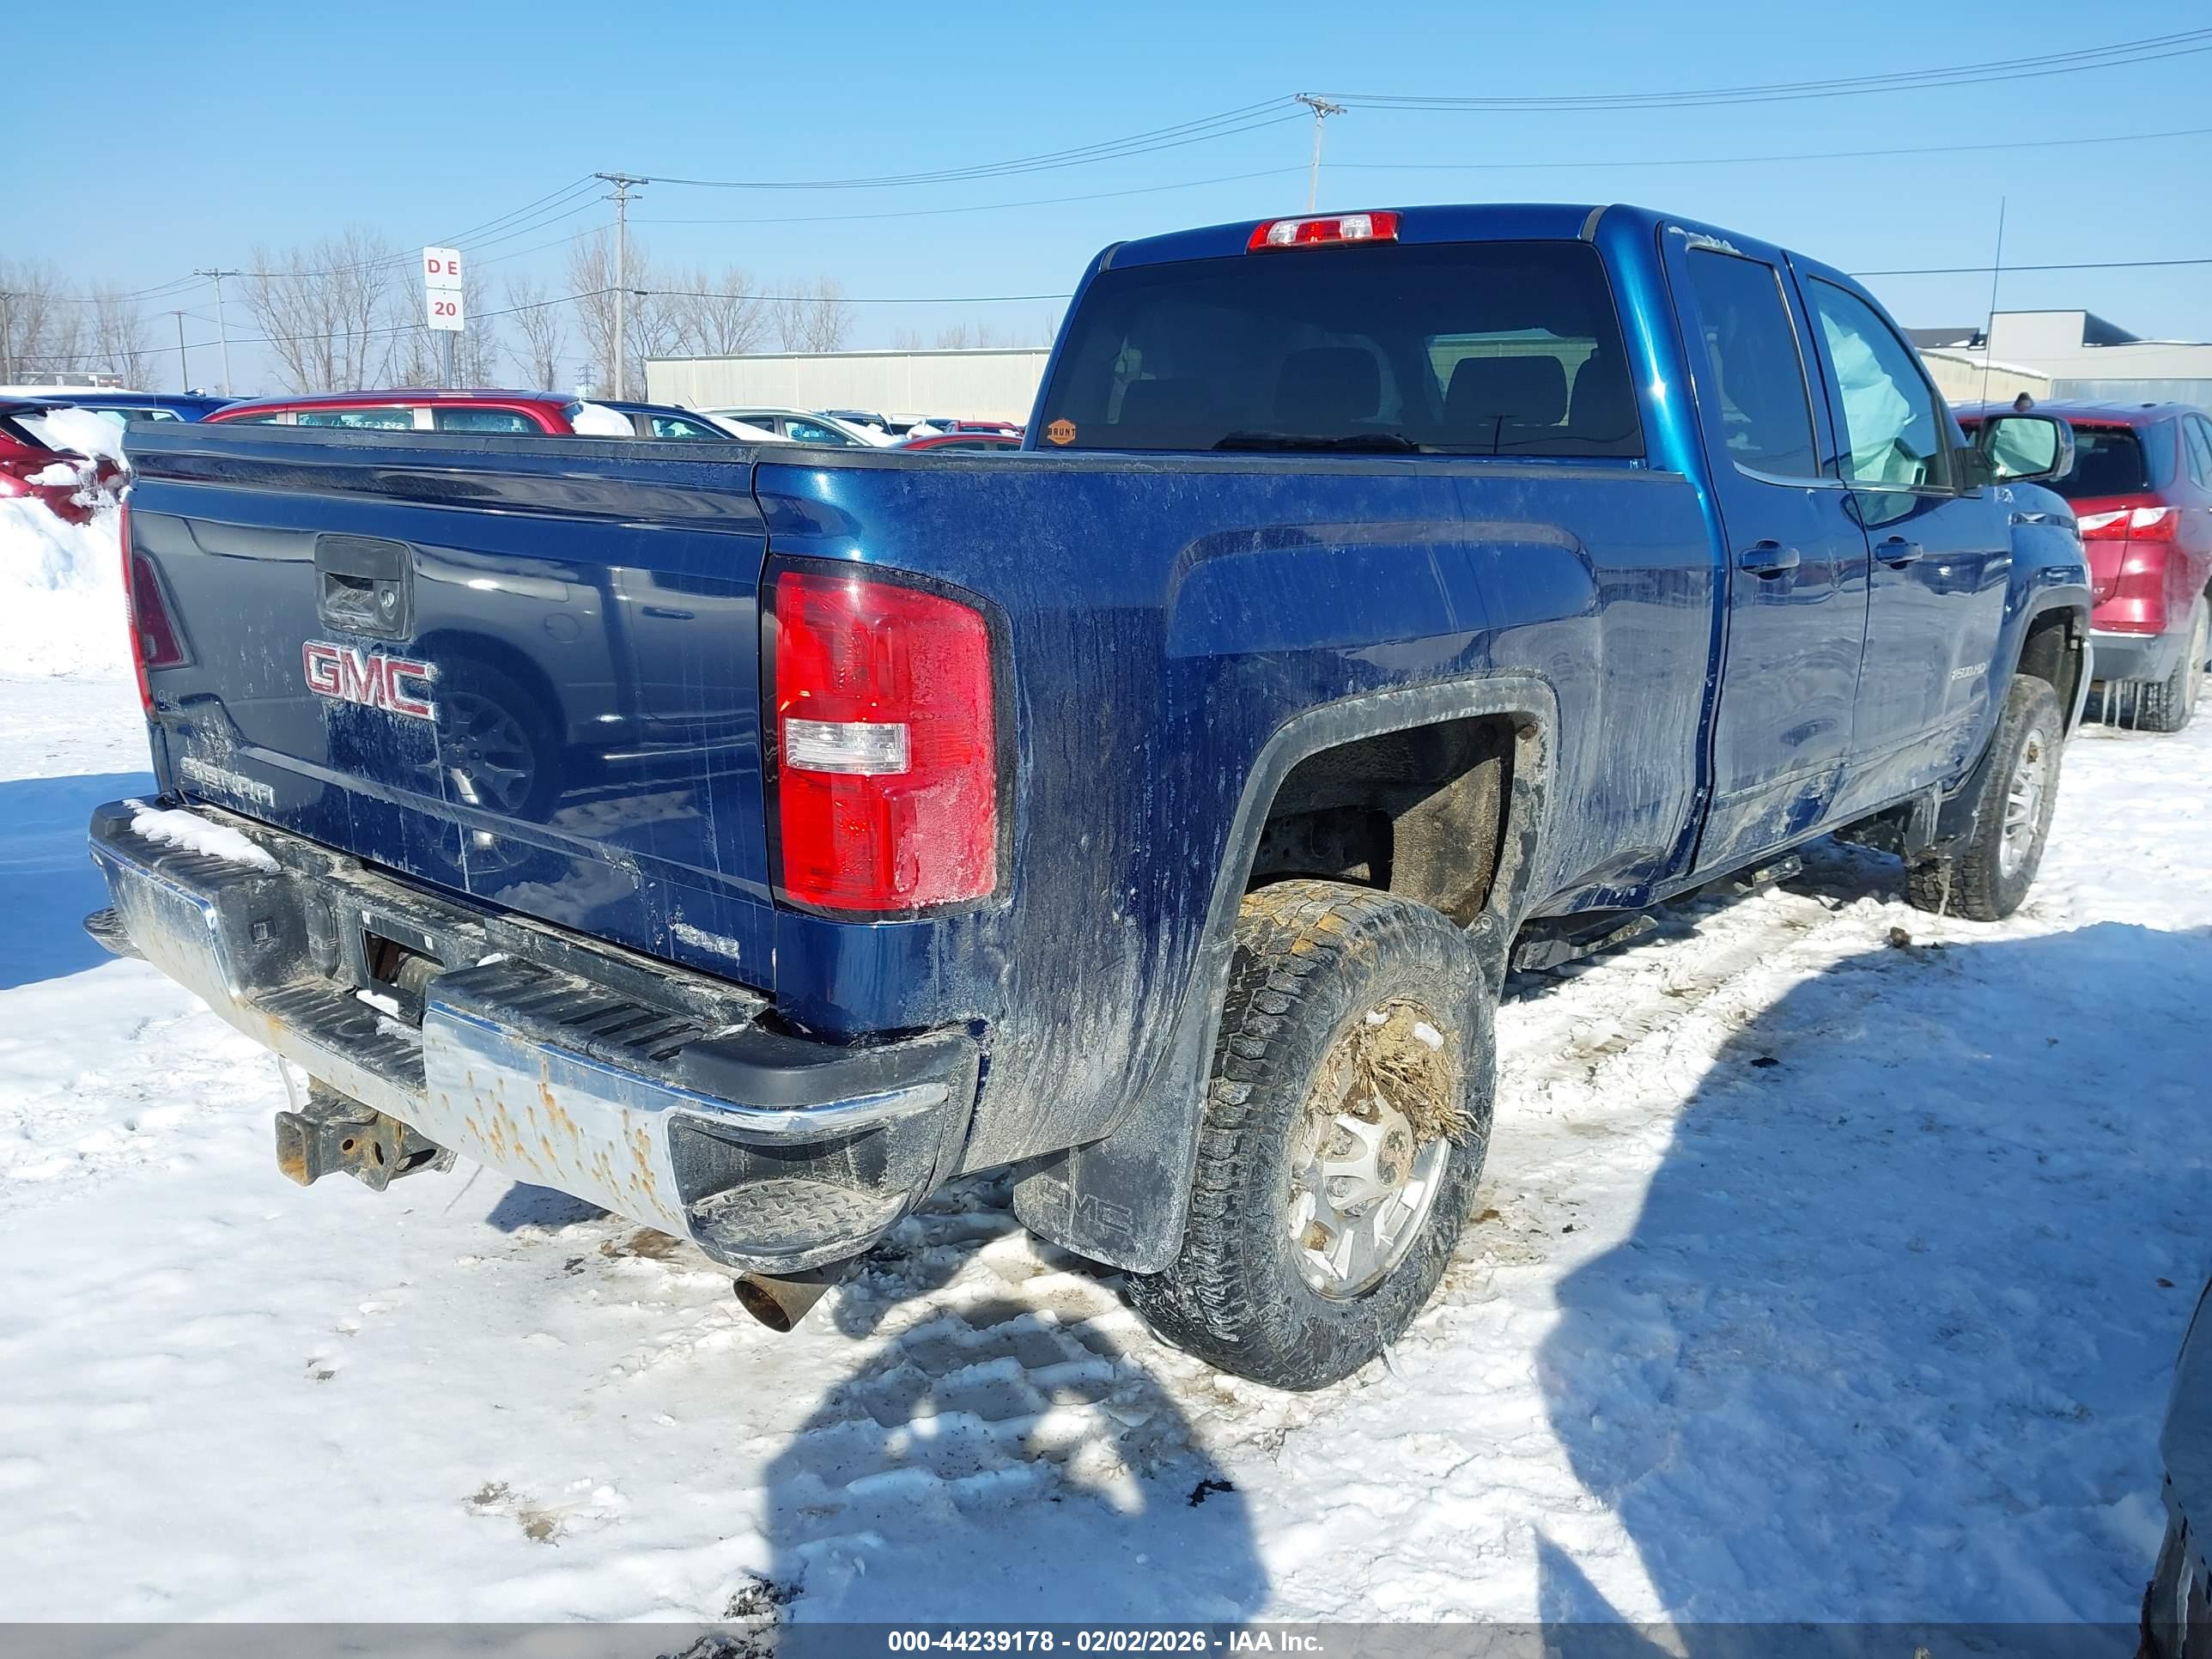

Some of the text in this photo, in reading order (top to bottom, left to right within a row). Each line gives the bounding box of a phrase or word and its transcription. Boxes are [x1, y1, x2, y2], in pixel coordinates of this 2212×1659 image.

[428, 259, 458, 275] D E
[434, 301, 456, 316] 20
[1048, 428, 1076, 436] BRUNT
[302, 639, 441, 721] GMC
